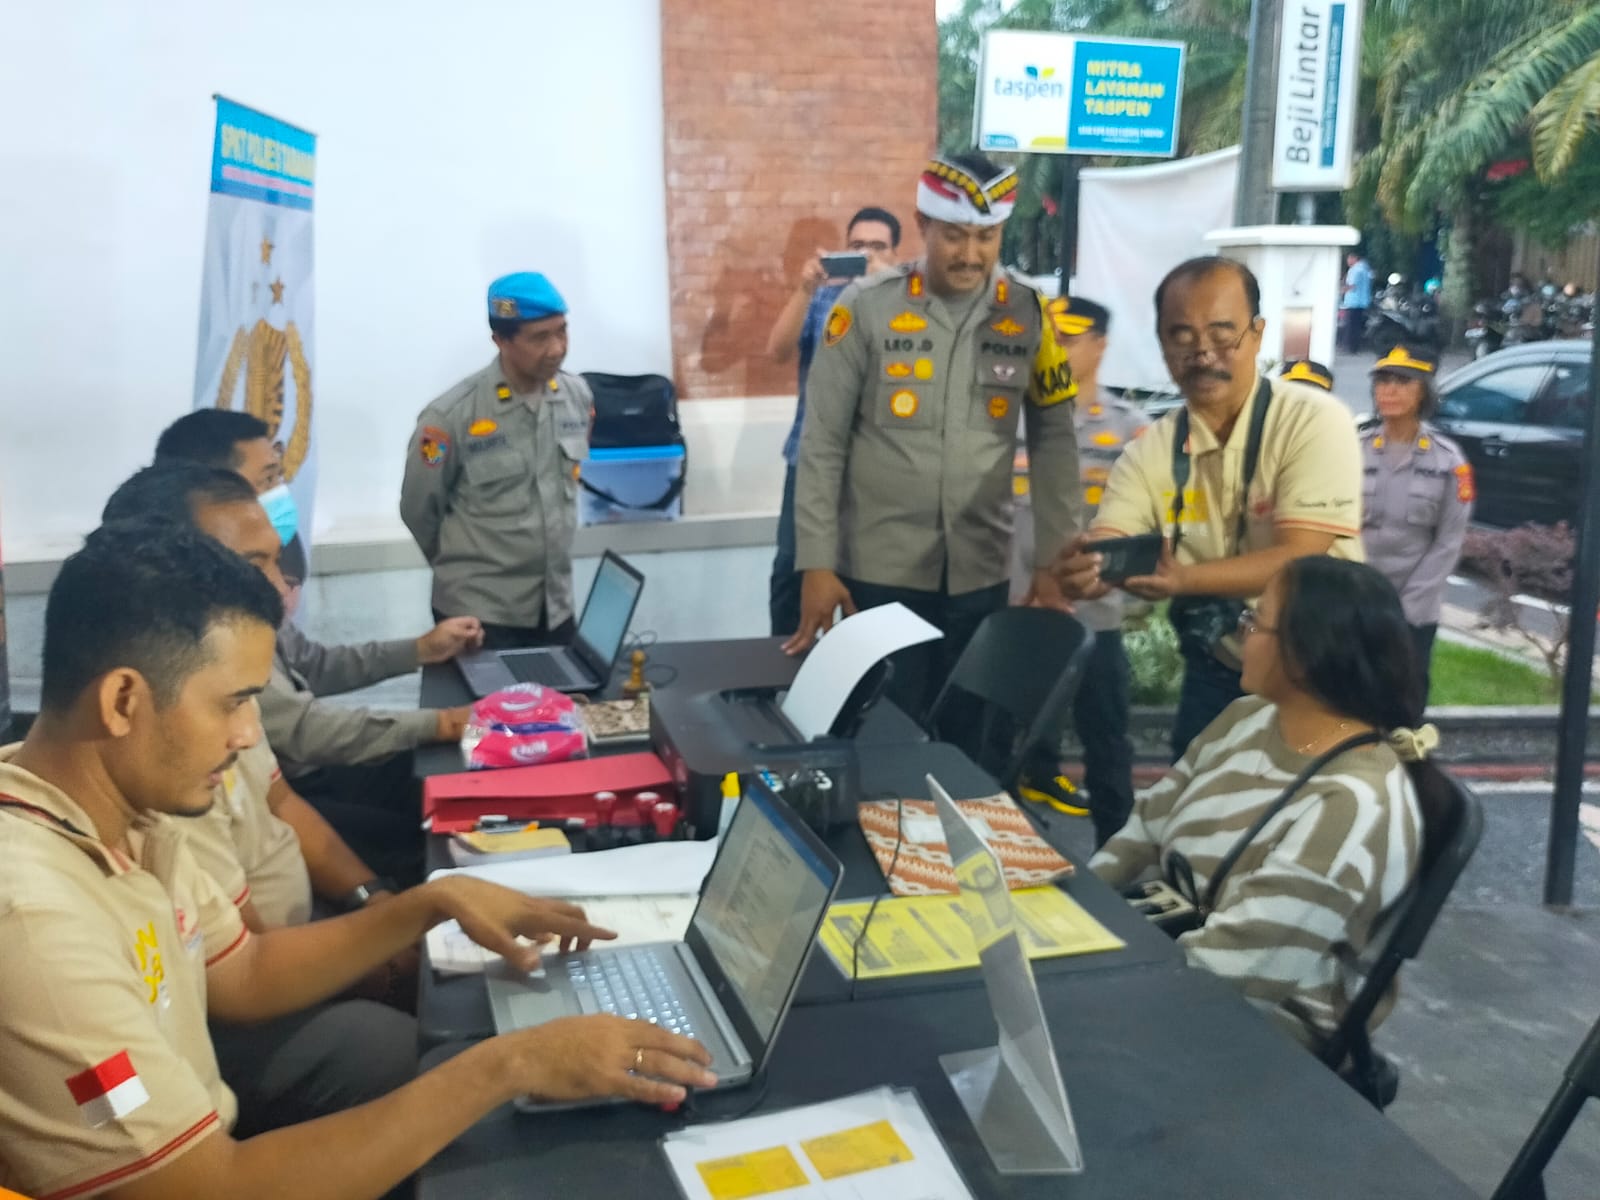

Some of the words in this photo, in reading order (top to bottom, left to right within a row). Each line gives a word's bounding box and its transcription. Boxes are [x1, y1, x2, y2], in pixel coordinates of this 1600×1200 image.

[1290, 6, 1320, 100] Lintar
[1086, 60, 1142, 78] MITRA
[994, 78, 1064, 101] taspen
[1084, 99, 1152, 117] TASPEN
[1286, 106, 1318, 164] Beji
